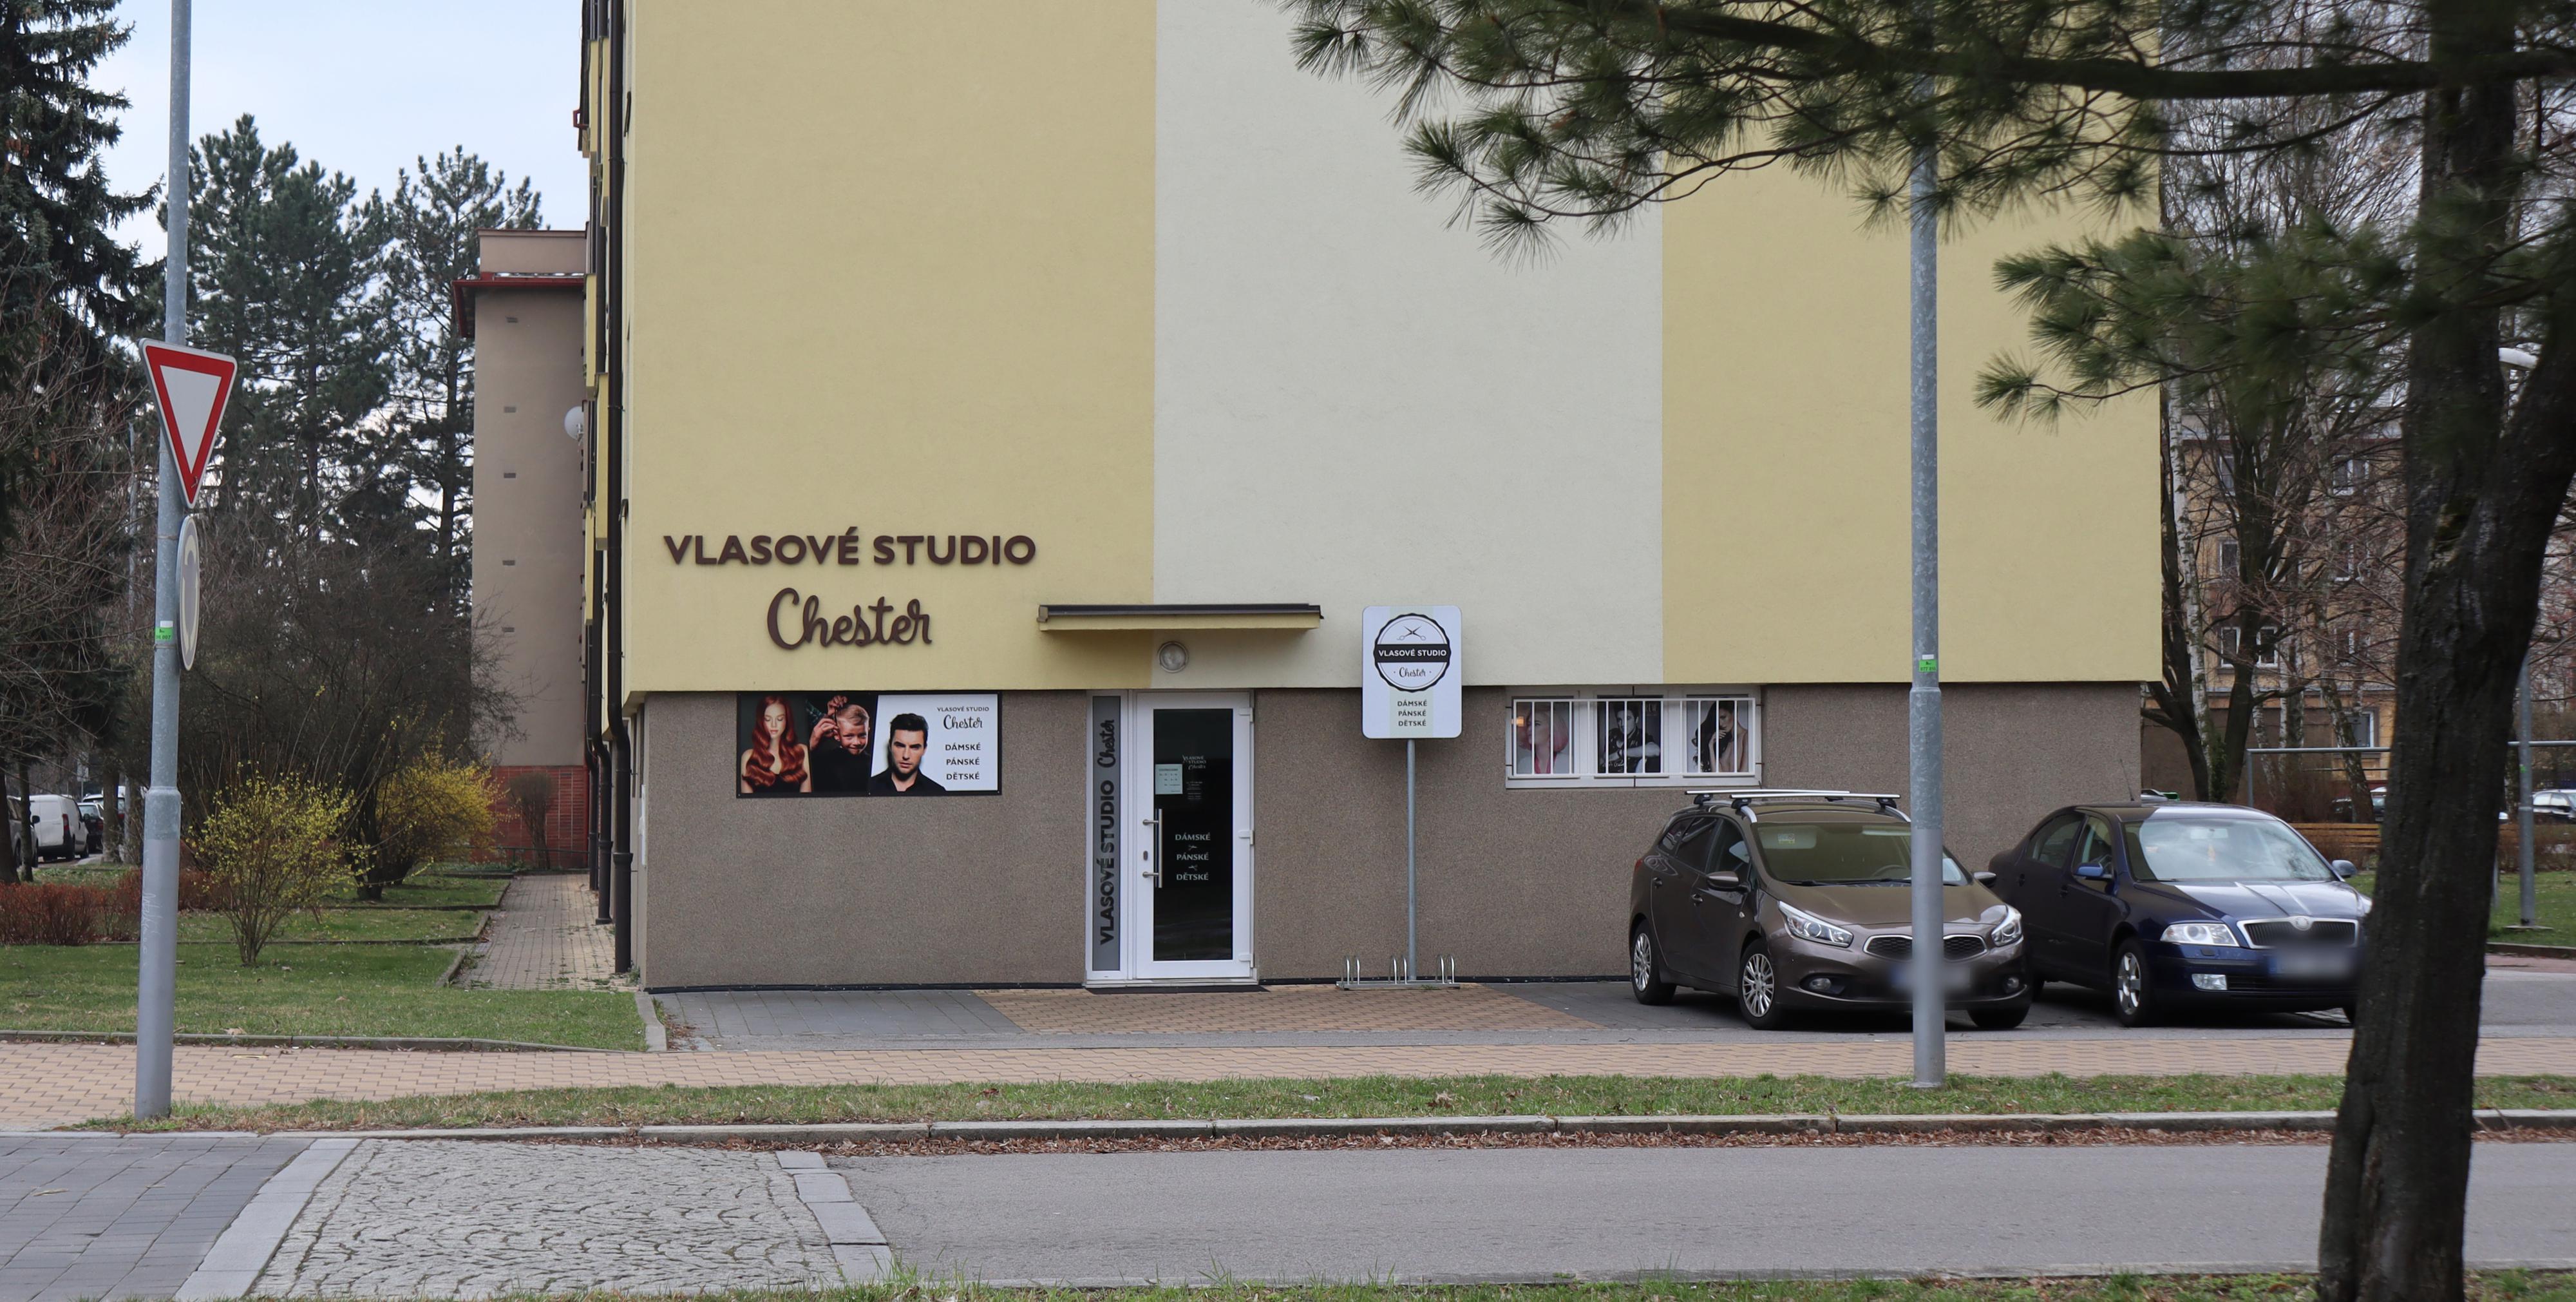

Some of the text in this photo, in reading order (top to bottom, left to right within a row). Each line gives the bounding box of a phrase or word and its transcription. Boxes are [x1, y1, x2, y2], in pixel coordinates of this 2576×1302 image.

[663, 526, 1036, 566] VLASOVÉ STUDIO
[767, 587, 932, 651] Chester
[1378, 648, 1416, 656] VLASOVÉ
[1399, 667, 1426, 678] Chester
[943, 714, 983, 730] Chester
[945, 742, 981, 751] DÁMSKÉ
[946, 757, 980, 765] PÁNSKÉ
[946, 771, 980, 780] DĚTSKÉ
[1097, 719, 1115, 945] VLASOVÉ STUDIO Chester
[1175, 832, 1211, 841] DÁMSKÉ
[1176, 852, 1209, 861] PÁNSKÉ
[1176, 872, 1209, 881] DĚTSKÉ
